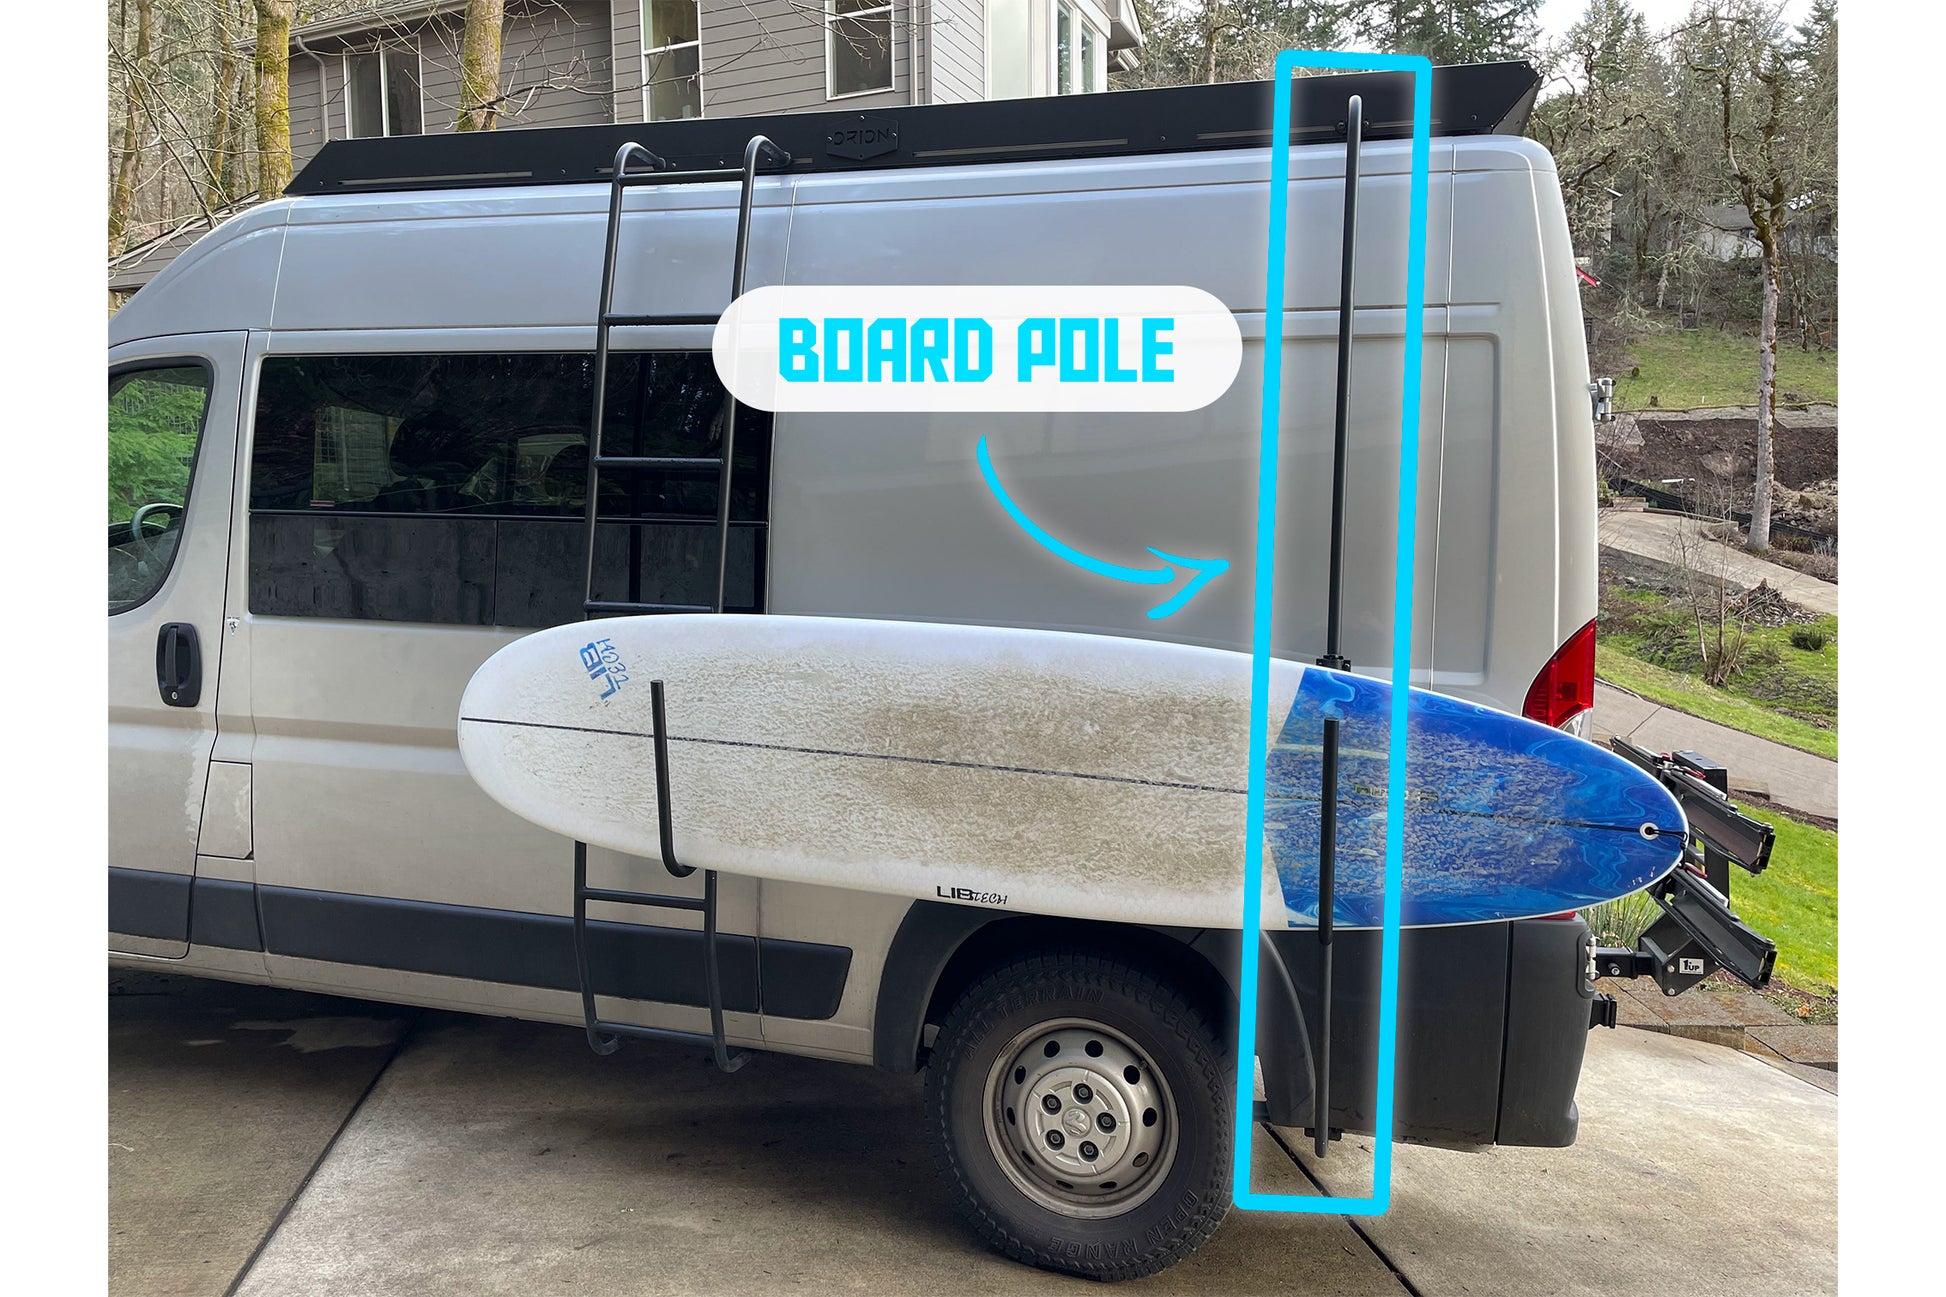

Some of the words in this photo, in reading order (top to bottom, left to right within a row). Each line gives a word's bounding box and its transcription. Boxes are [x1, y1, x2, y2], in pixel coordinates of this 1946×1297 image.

[833, 127, 891, 146] ORION
[579, 642, 617, 701] LIB
[596, 637, 629, 690] TECH
[963, 1017, 994, 1061] ALL
[997, 984, 1104, 1018] TERRAIN
[1145, 1188, 1199, 1245] OPEN
[1048, 1236, 1139, 1260] RANGE
